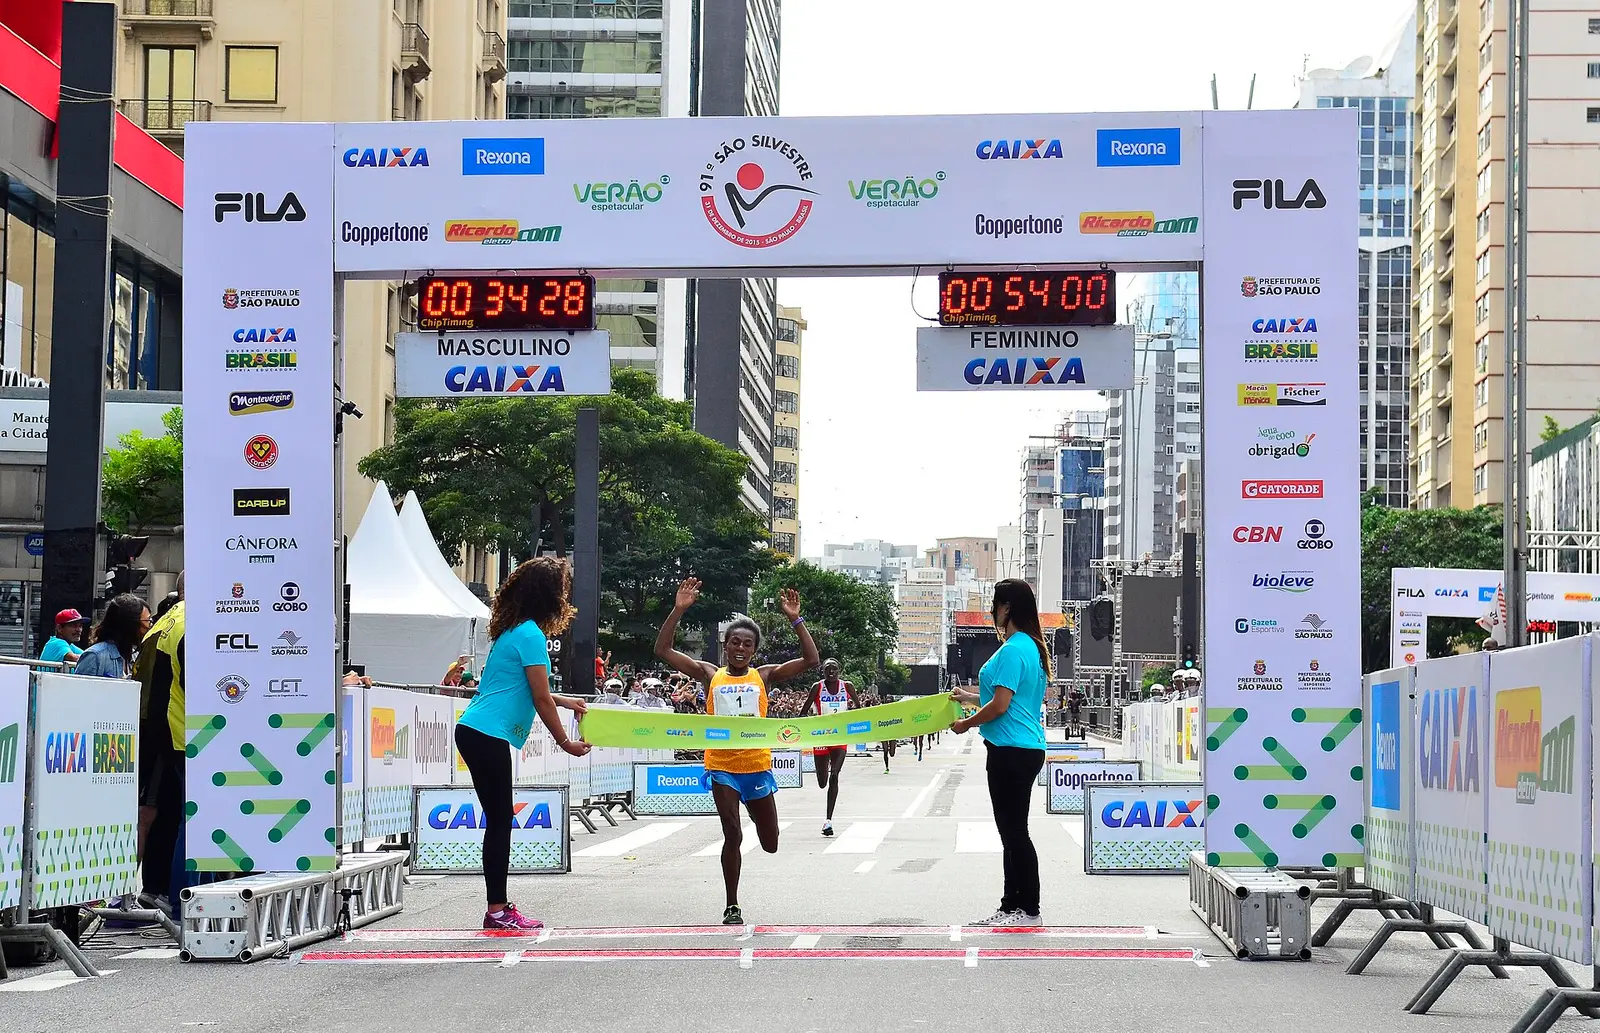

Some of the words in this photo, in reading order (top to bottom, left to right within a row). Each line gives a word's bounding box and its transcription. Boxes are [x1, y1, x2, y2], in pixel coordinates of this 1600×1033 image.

[976, 139, 1063, 160] CAIXA
[1111, 140, 1166, 156] Rexona
[343, 147, 430, 167] CAIXA
[476, 149, 531, 165] Rexona
[714, 138, 746, 164] SÃO
[752, 135, 813, 181] SILVESTRE
[573, 178, 664, 204] VERÃO
[848, 175, 939, 200] VERÃO
[1232, 178, 1327, 210] FILA
[214, 191, 307, 222] FILA
[591, 200, 645, 212] espetacular
[866, 198, 920, 209] espetacular
[711, 217, 736, 240] DEZEMBRO
[745, 238, 760, 246] 2015
[765, 236, 778, 245] SÃO
[778, 225, 795, 240] PAULO
[795, 205, 809, 224] BRASIL
[975, 213, 1064, 239] Coppertone
[1081, 215, 1152, 229] Ricardo
[341, 220, 429, 246] Coppertone
[447, 224, 518, 237] Ricardo
[1118, 229, 1149, 237] eletro
[483, 237, 512, 245] eletro
[289, 289, 300, 297] DE
[945, 276, 993, 313] 00
[1004, 276, 1050, 311] 54
[1060, 275, 1107, 310] 00
[1259, 285, 1282, 295] SÃO
[1284, 286, 1321, 295] PAULO
[240, 297, 263, 308] SÃO
[265, 298, 300, 307] PAULO
[426, 281, 473, 316] 00
[485, 281, 529, 316] 34
[538, 281, 586, 316] 28
[421, 318, 474, 329] ChipTiming
[943, 313, 997, 324] ChipTiming
[1252, 318, 1318, 333] CAIXA
[233, 328, 297, 343] CAIXA
[970, 330, 1079, 348] FEMININO
[437, 338, 571, 356] MASCULINO
[1244, 343, 1318, 359] BRASIL
[226, 353, 297, 368] BRASIL
[444, 364, 565, 393] CAIXA
[963, 357, 1086, 385] CAIXA
[1284, 386, 1321, 396] Fischer
[1276, 431, 1296, 441] coco
[1248, 443, 1310, 459] obrigado
[1258, 484, 1320, 494] GATORADE
[1232, 526, 1283, 543] CBN
[225, 534, 298, 551] CÂNFORA
[1296, 540, 1334, 550] GLOBO
[1252, 573, 1315, 587] bioleve
[1397, 588, 1425, 598] FILA
[1434, 588, 1469, 598] CAIXA
[216, 605, 233, 613] SÃO
[234, 605, 260, 613] PAULO
[272, 602, 308, 612] GLOBO
[1251, 626, 1285, 634] Esportiva
[1294, 631, 1310, 639] SÃO
[215, 633, 259, 650] FCL
[271, 648, 286, 656] SÃO
[233, 676, 249, 688] MILITAR
[268, 679, 303, 693] CET
[720, 685, 754, 694] CAIXA
[1237, 682, 1255, 691] SÃO
[736, 695, 742, 708] 1
[821, 695, 846, 703] CAIXA
[116, 722, 136, 731] FEDERAL
[373, 717, 395, 745] Ricardo
[666, 729, 694, 737] CAIXA
[811, 728, 838, 736] CAIXA
[414, 704, 448, 775] Coppertone
[1419, 686, 1480, 793] CAIXA
[1497, 708, 1540, 762] Ricardo
[45, 731, 87, 774] CAIXA
[92, 733, 136, 774] BRASIL
[1376, 722, 1396, 771] Rexona
[110, 776, 135, 785] EDUCADORA
[657, 775, 699, 787] Rexona
[1517, 775, 1536, 800] eletro
[1101, 800, 1205, 828] CAIX
